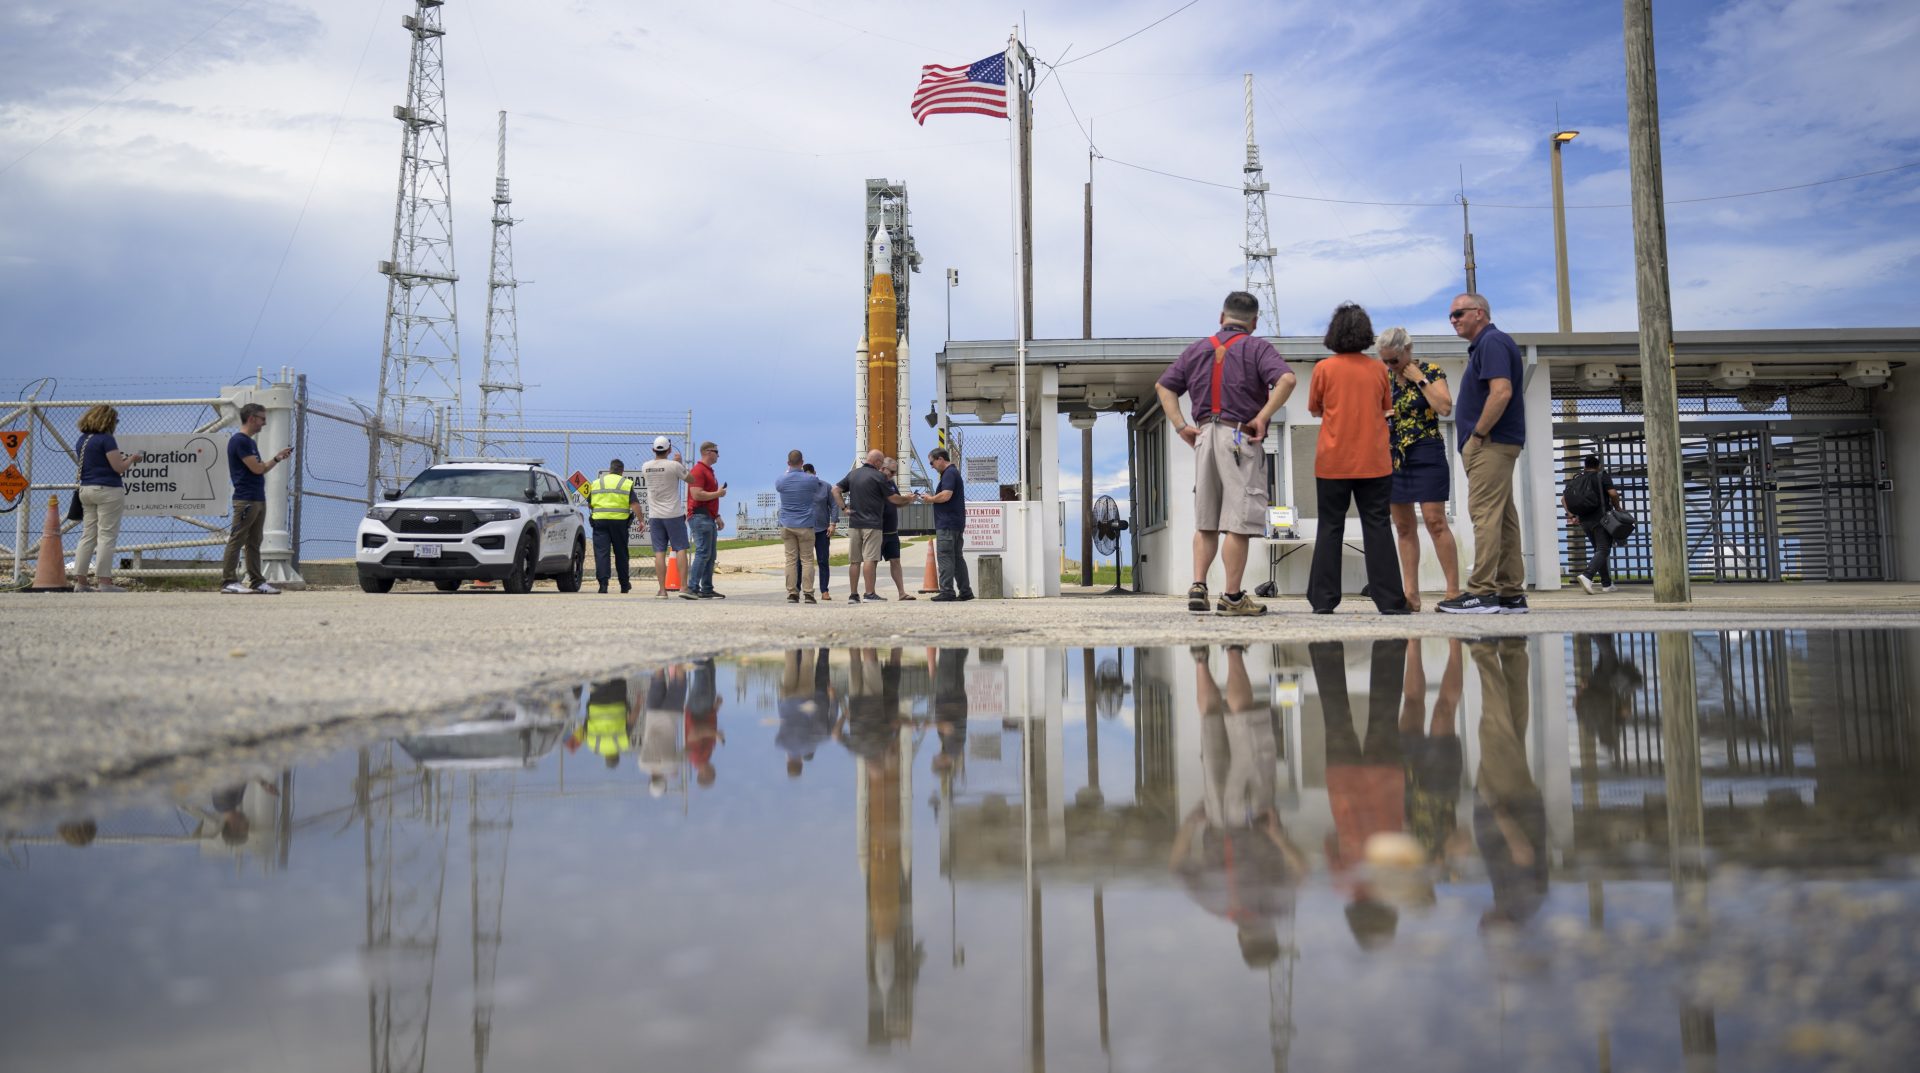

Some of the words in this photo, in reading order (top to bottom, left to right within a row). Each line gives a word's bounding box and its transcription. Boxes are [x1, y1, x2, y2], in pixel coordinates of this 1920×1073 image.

[7, 435, 18, 448] 3
[121, 465, 168, 478] round
[574, 474, 580, 485] 4
[124, 481, 177, 495] ystems
[583, 484, 590, 494] 3
[964, 508, 1000, 516] ATTENTION
